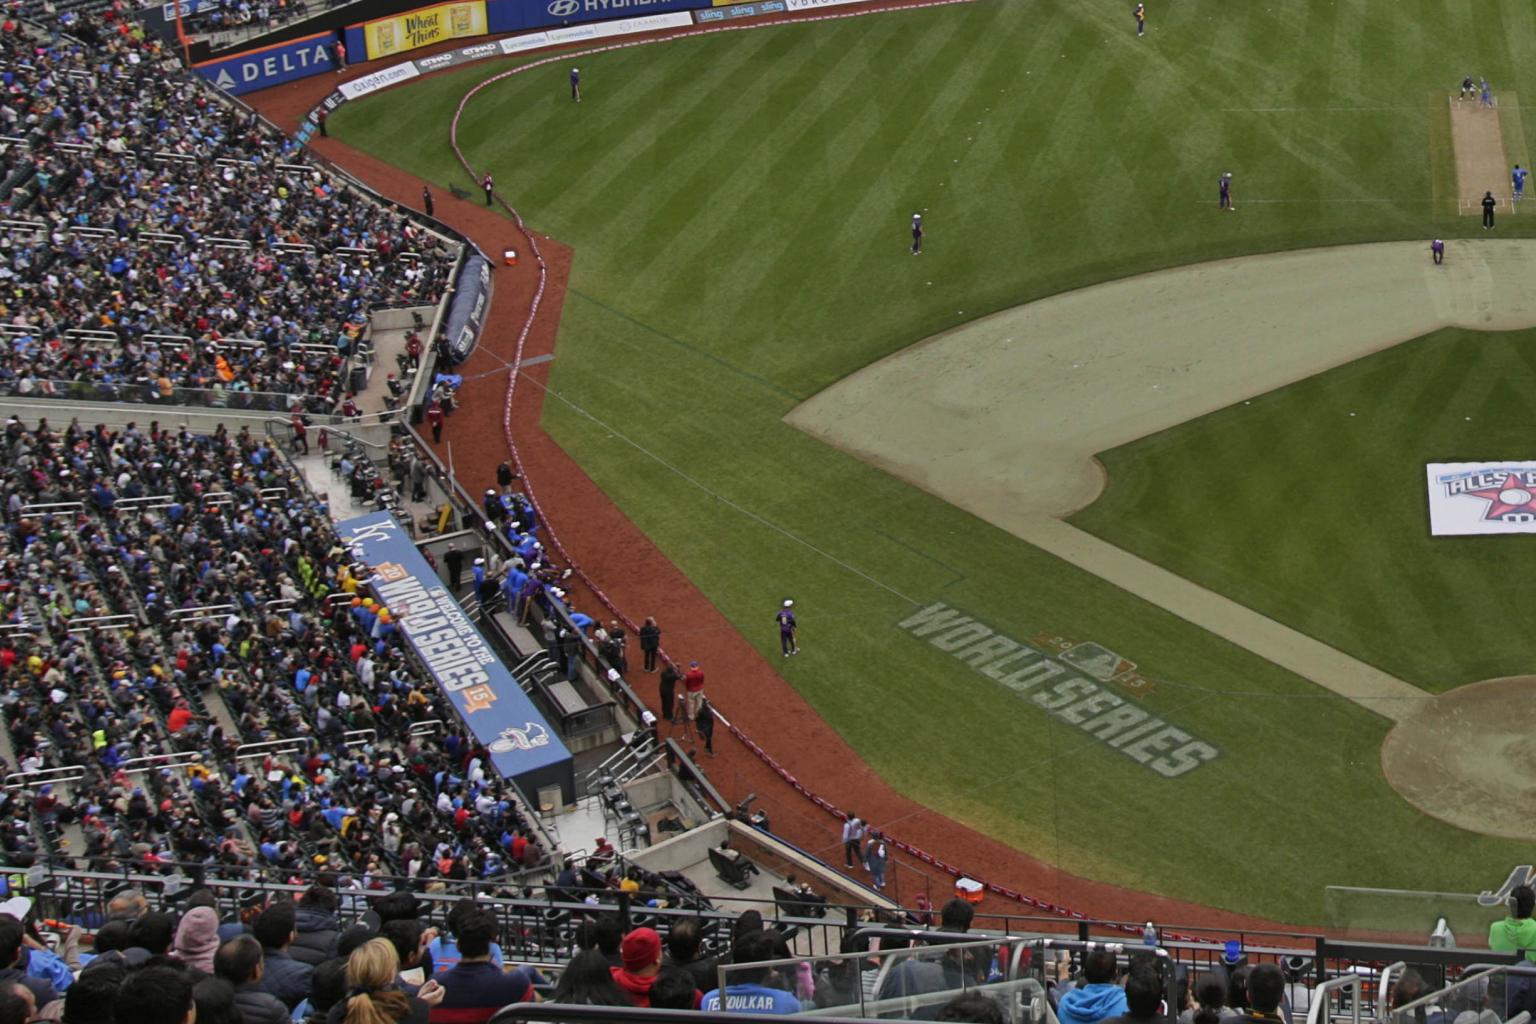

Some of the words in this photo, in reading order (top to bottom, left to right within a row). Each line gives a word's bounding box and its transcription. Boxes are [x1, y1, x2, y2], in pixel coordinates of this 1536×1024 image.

[700, 9, 724, 22] sling
[731, 5, 754, 17] sling
[761, 1, 784, 13] sling
[406, 14, 438, 33] Wheat
[405, 27, 440, 48] Thins
[462, 43, 496, 56] ETIHAD
[242, 45, 328, 82] DELTA
[420, 54, 452, 67] ETIHAD
[435, 595, 474, 636] WELCOME
[377, 575, 449, 635] WORLD
[414, 627, 489, 692] SERIES
[463, 634, 482, 648] TO
[471, 646, 496, 665] THE
[898, 601, 1066, 693] WORLD
[1032, 677, 1219, 777] SERIES
